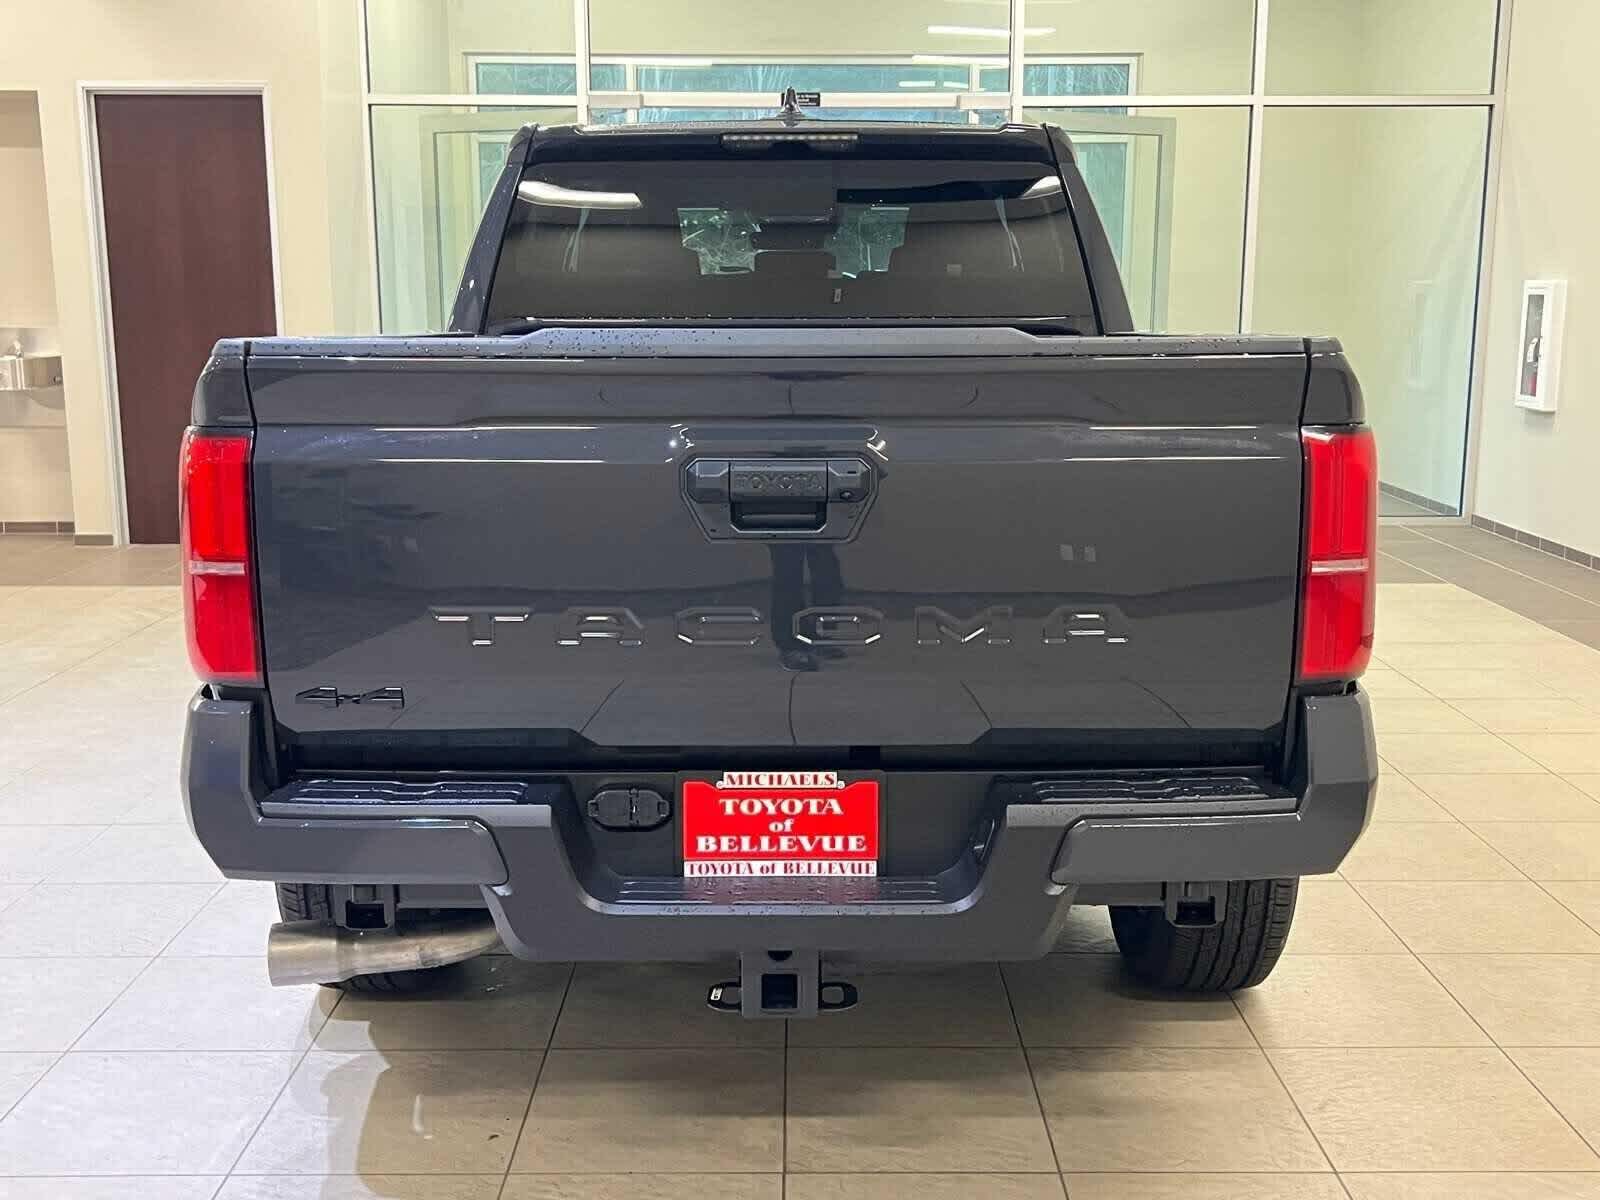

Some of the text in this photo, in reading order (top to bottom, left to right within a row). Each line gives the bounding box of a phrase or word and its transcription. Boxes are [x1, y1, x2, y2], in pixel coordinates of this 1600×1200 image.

[735, 473, 825, 490] TOYOTA
[428, 605, 1129, 646] TACOMA
[726, 773, 835, 785] MICHAELS
[719, 798, 843, 815] TOYOTA
[768, 818, 794, 832] of
[695, 835, 867, 853] BELLEVUE
[687, 862, 875, 875] TOYOTA of BELLEVUE
